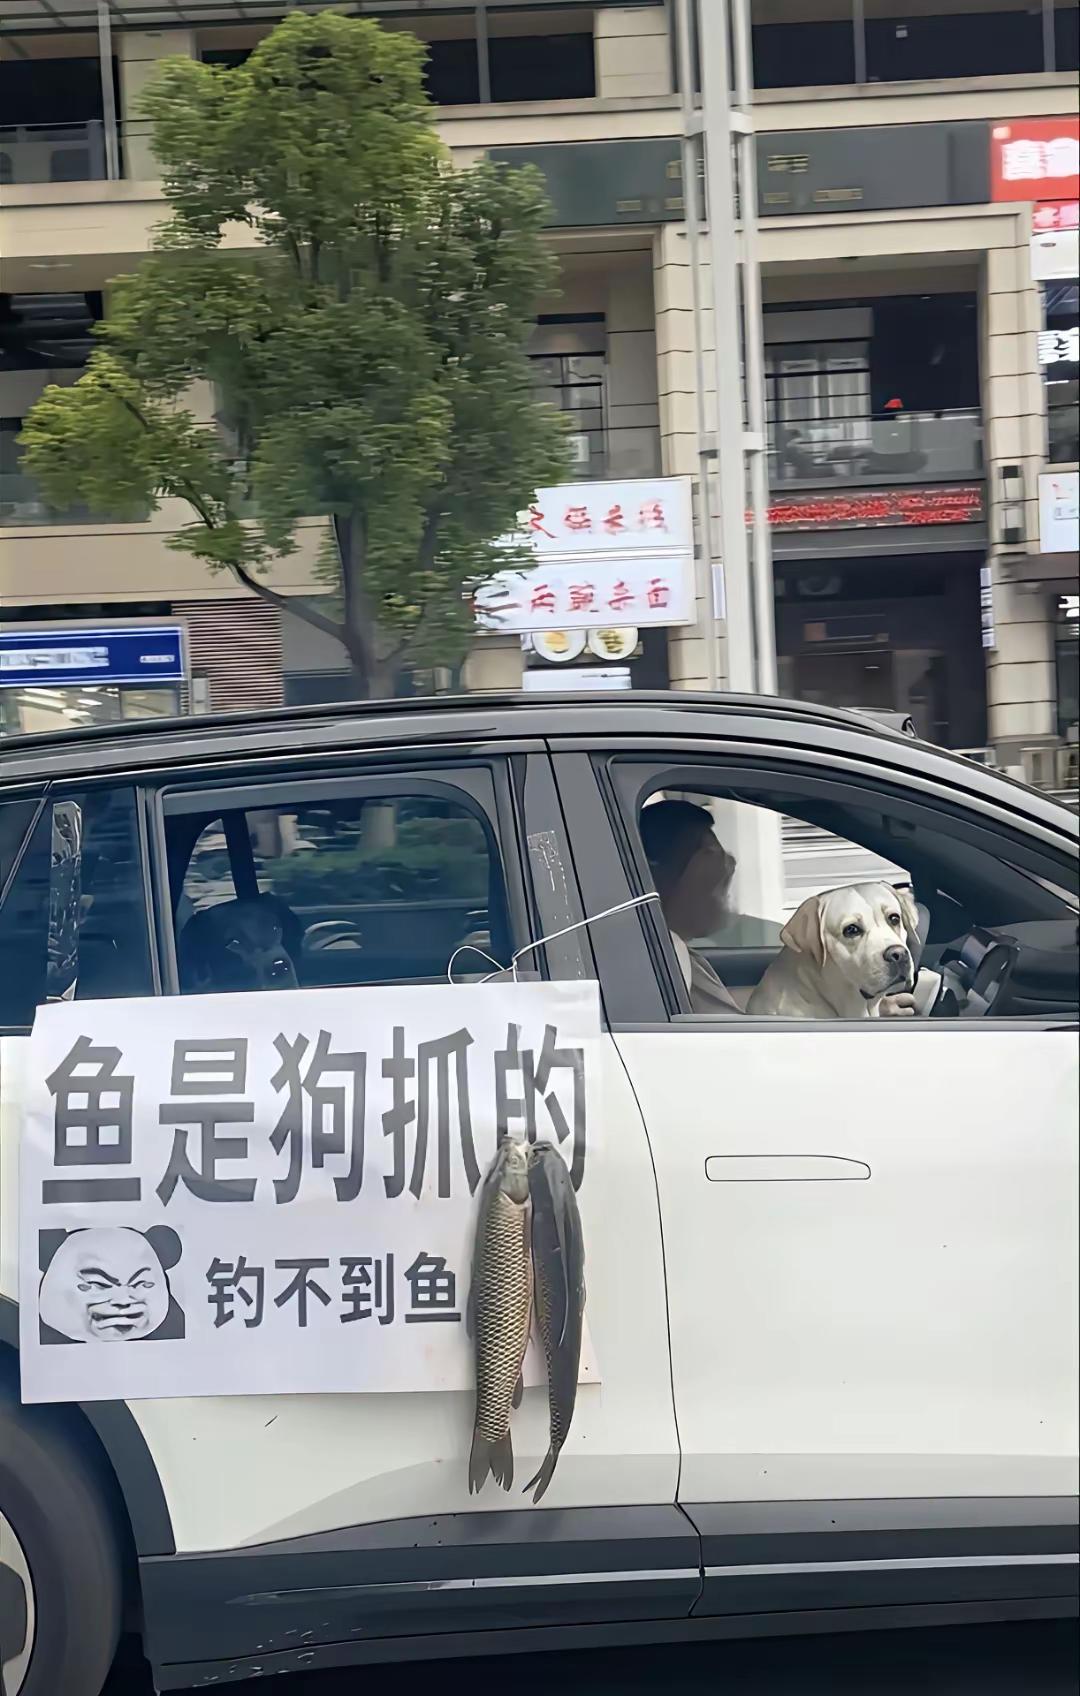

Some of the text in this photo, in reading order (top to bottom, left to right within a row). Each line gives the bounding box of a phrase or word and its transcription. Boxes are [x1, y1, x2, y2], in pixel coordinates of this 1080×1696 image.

[41, 1023, 586, 1206] 鱼是狗抓的
[206, 1252, 462, 1329] 钓不到鱼
